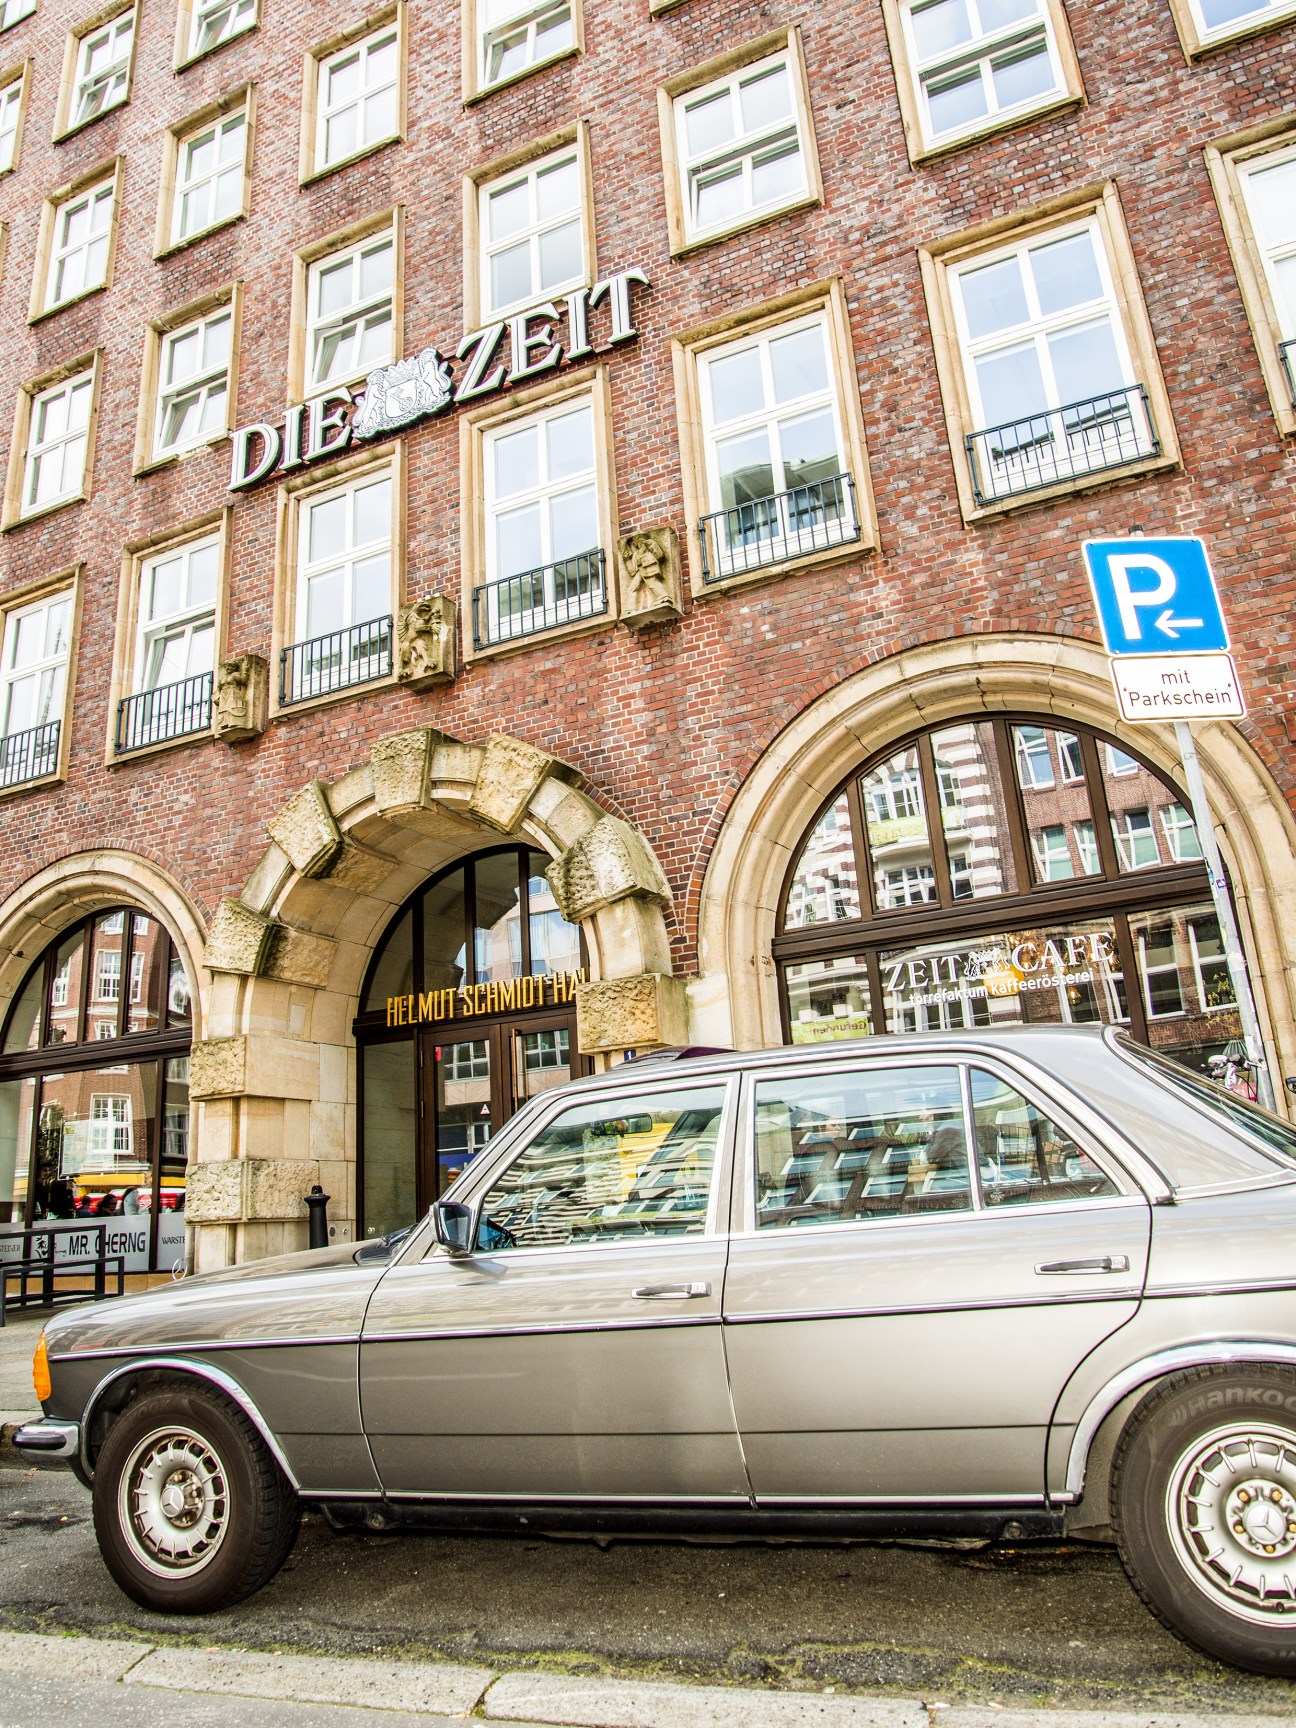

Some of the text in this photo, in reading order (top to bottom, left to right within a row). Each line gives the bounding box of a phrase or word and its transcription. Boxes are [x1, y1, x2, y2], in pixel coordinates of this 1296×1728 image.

[226, 266, 653, 493] DIE ZEIT
[1107, 553, 1176, 640] P
[1161, 669, 1191, 685] mit
[1128, 688, 1232, 707] Parkschein
[885, 954, 961, 992] ZEIT
[909, 968, 1094, 1007] torrefaktum kaffeerösterei
[387, 987, 457, 1027] HELMUT
[463, 973, 547, 1016] SCHMIDT
[69, 1235, 90, 1256] MR.
